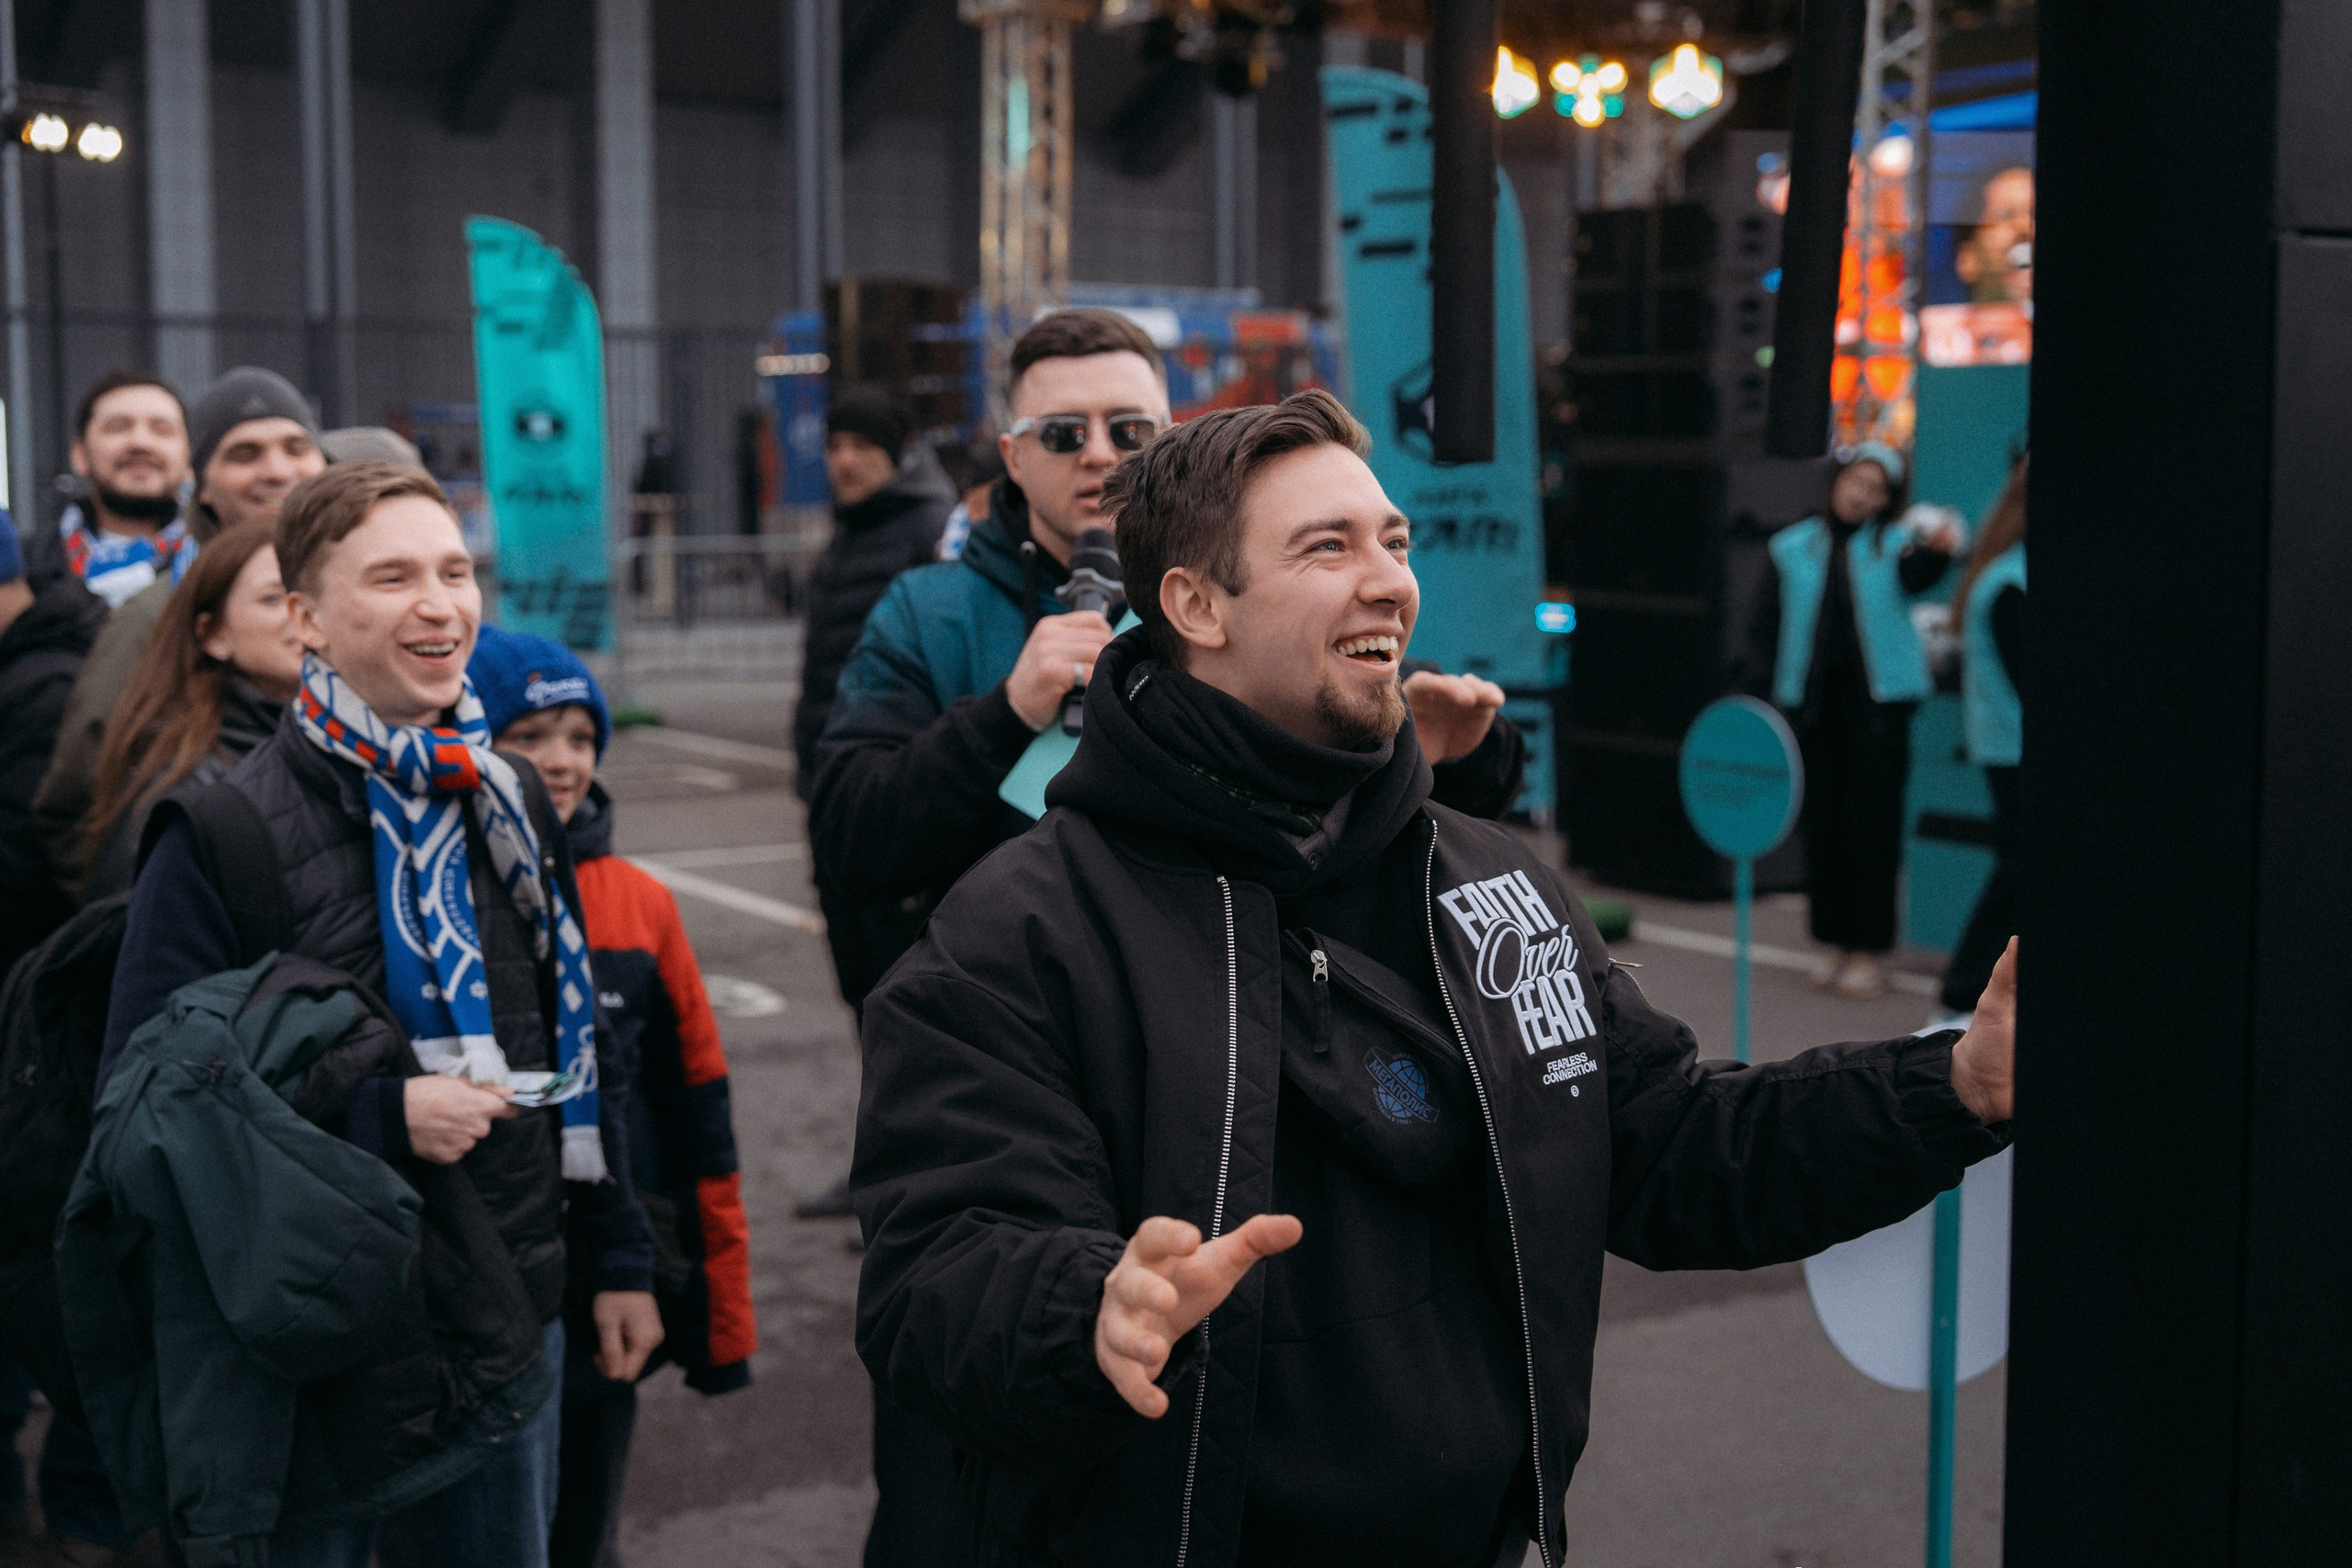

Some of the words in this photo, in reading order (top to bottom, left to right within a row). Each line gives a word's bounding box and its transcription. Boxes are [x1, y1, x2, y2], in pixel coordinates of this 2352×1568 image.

[1436, 869, 1558, 950] FAITH
[1476, 918, 1578, 999] Over
[1511, 969, 1597, 1055] FEAR
[1369, 1059, 1432, 1119] МЕГАПОЛИС
[1543, 1059, 1598, 1085] CONNECTION
[1546, 1052, 1588, 1073] FEARLESS
